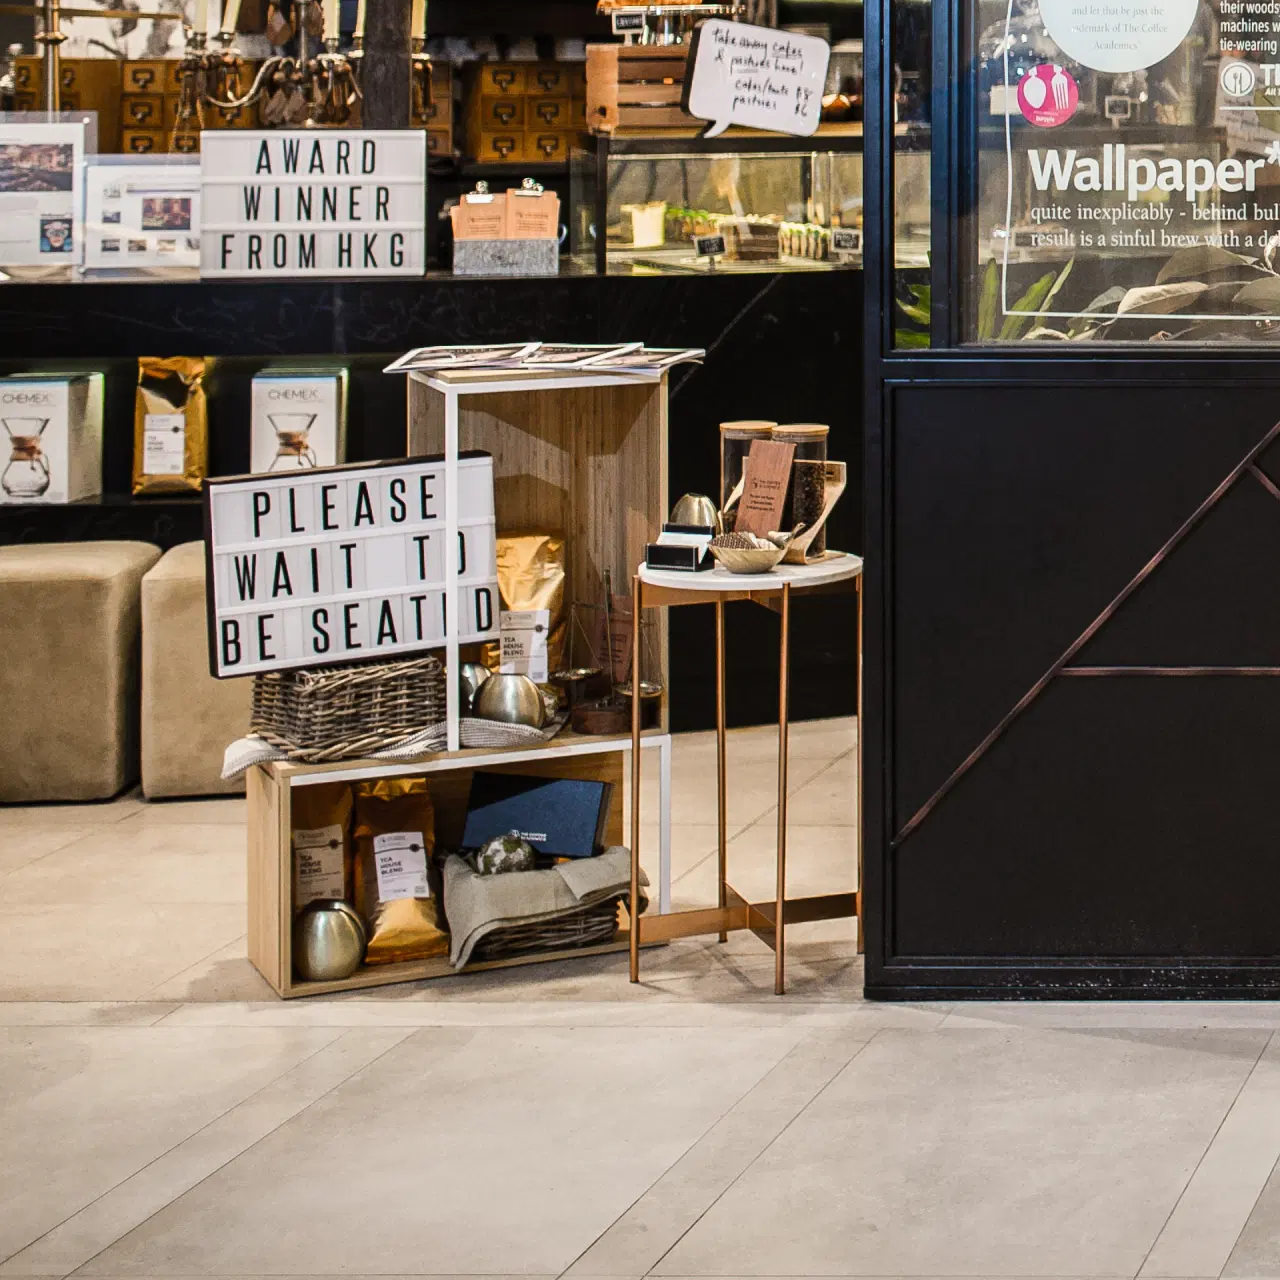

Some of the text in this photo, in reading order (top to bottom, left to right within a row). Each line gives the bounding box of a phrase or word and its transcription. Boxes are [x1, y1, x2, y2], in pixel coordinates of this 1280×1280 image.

[257, 138, 376, 176] AWARD
[243, 186, 390, 222] WINNER
[222, 233, 405, 269] FROM HKG
[253, 474, 438, 538] PLEASE
[235, 543, 356, 601] WAIT
[222, 587, 493, 667] BE SEATD
